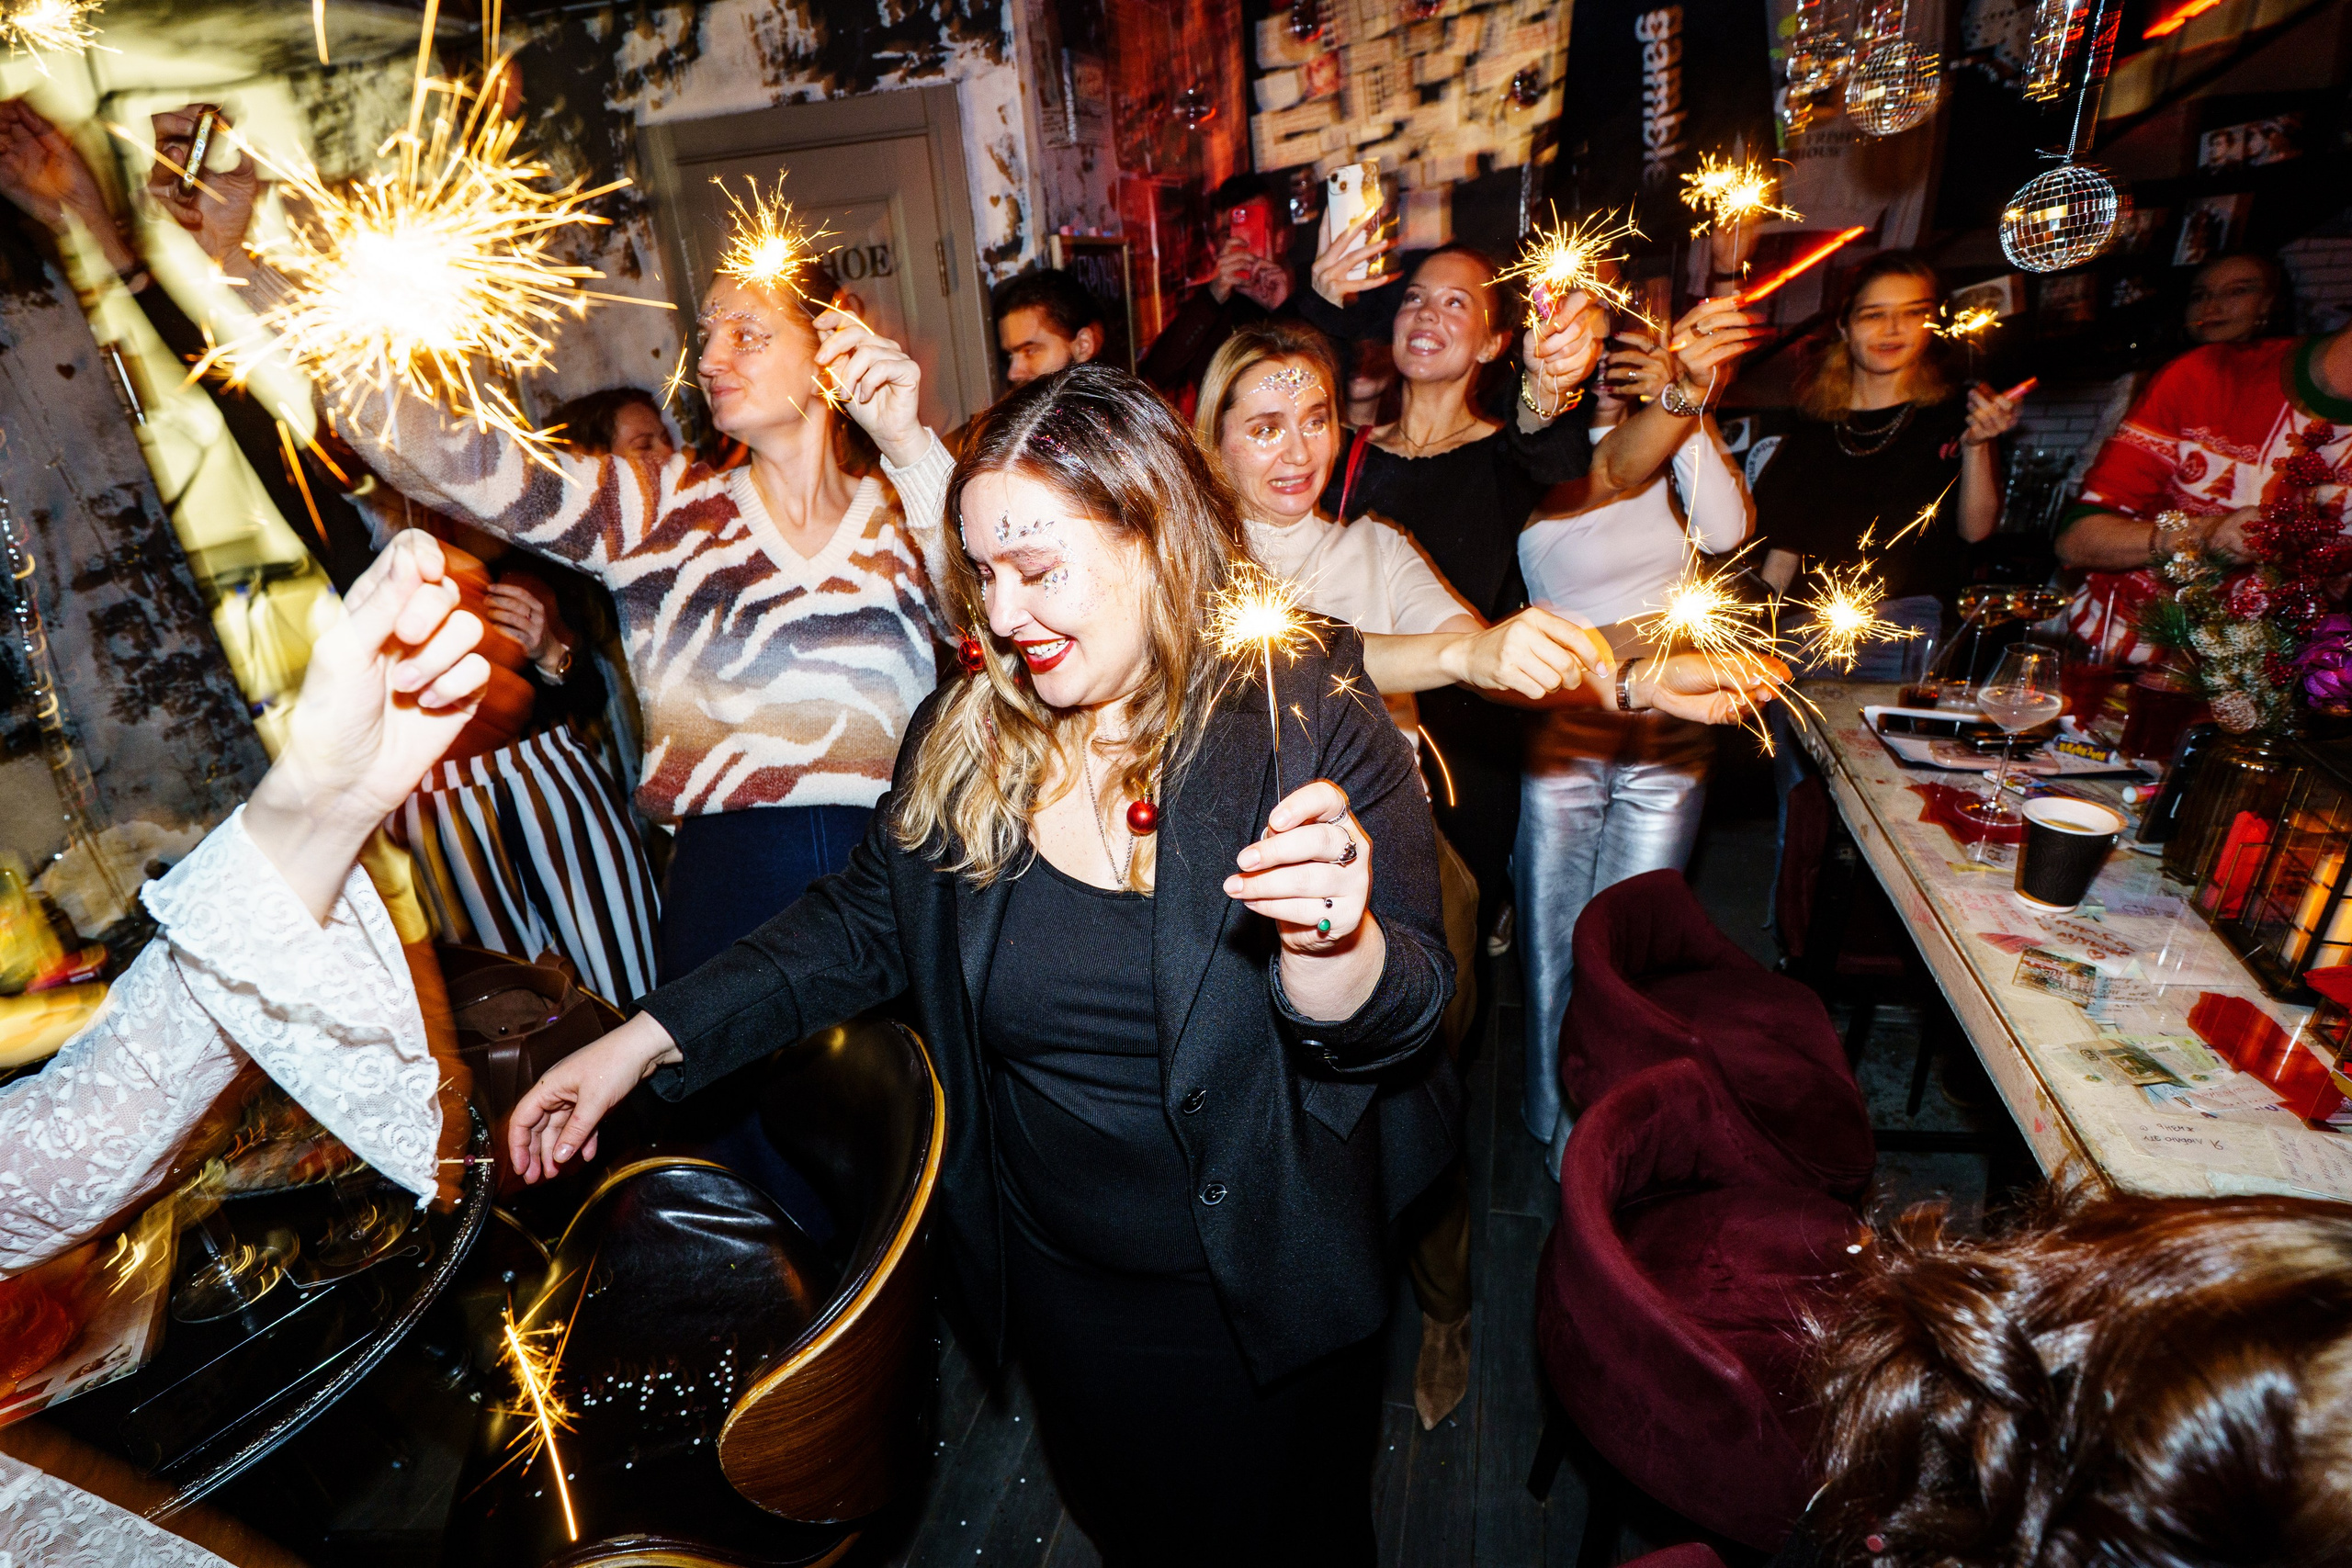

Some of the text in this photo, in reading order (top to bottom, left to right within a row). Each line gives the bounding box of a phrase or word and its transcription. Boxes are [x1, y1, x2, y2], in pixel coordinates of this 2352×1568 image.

[2155, 1122, 2195, 1133] жизнь
[2164, 1136, 2203, 1146] люблю
[2209, 1138, 2224, 1151] Я
